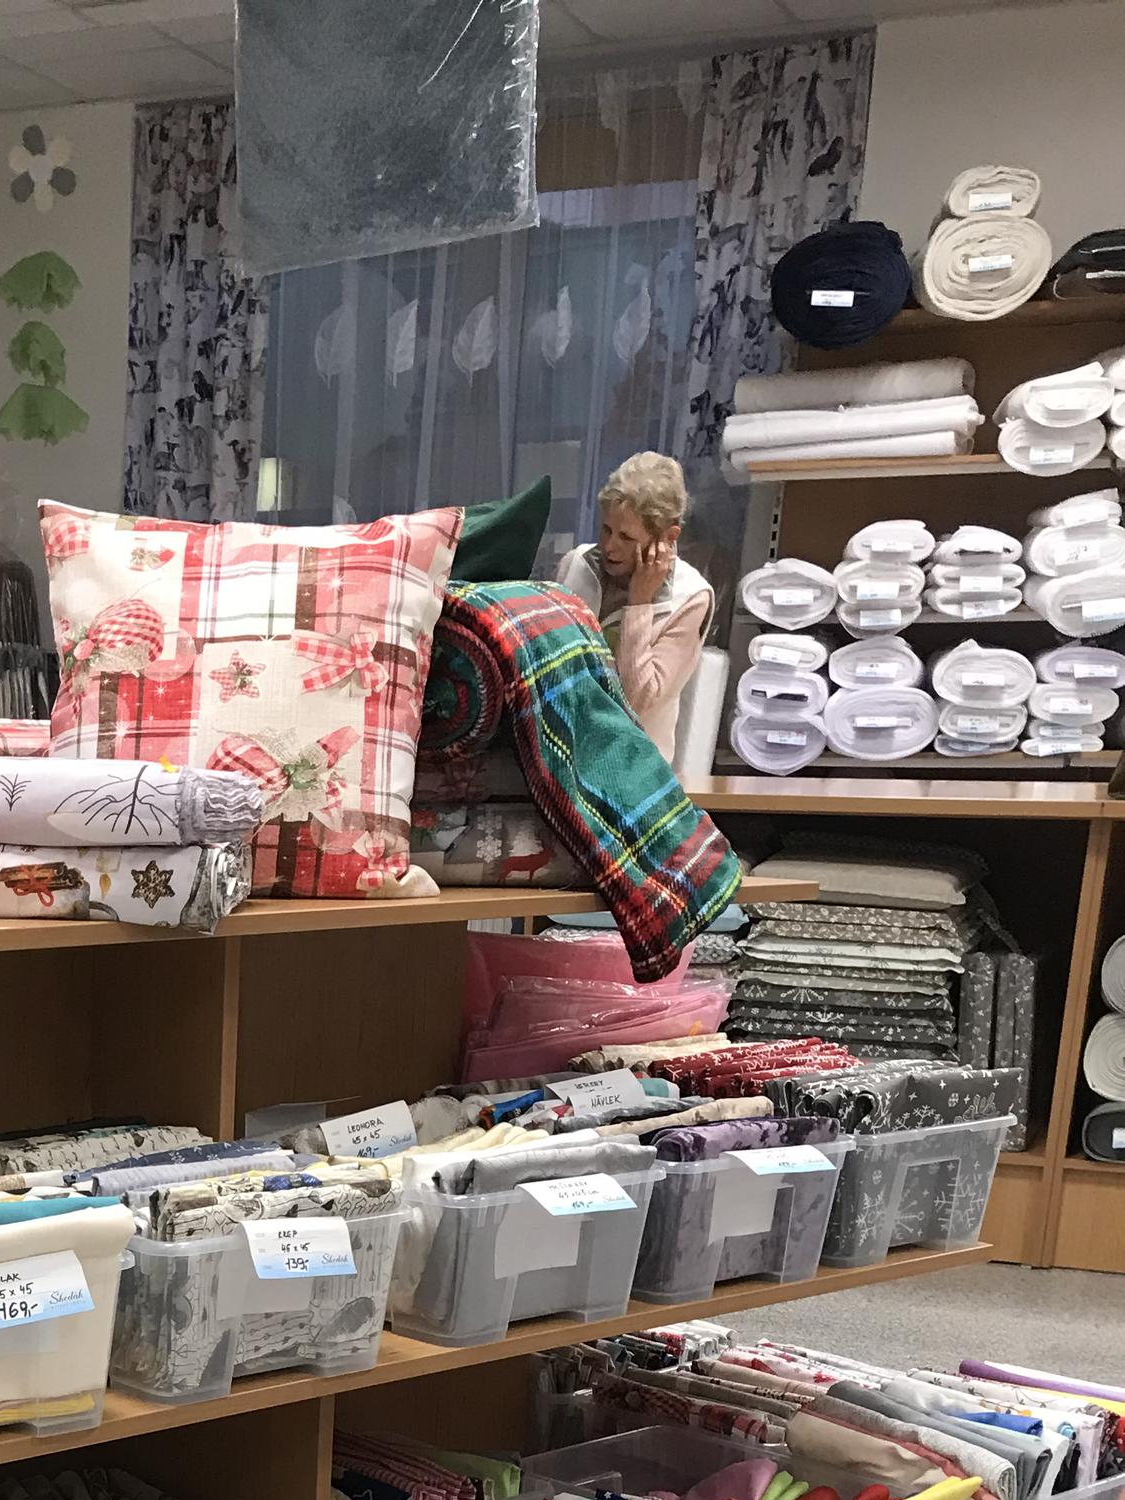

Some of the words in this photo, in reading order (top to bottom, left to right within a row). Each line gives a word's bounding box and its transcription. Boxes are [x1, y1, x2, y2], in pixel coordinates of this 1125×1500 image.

[347, 1118, 384, 1134] LEONORA
[370, 1129, 381, 1139] 45
[19, 1282, 33, 1295] 45
